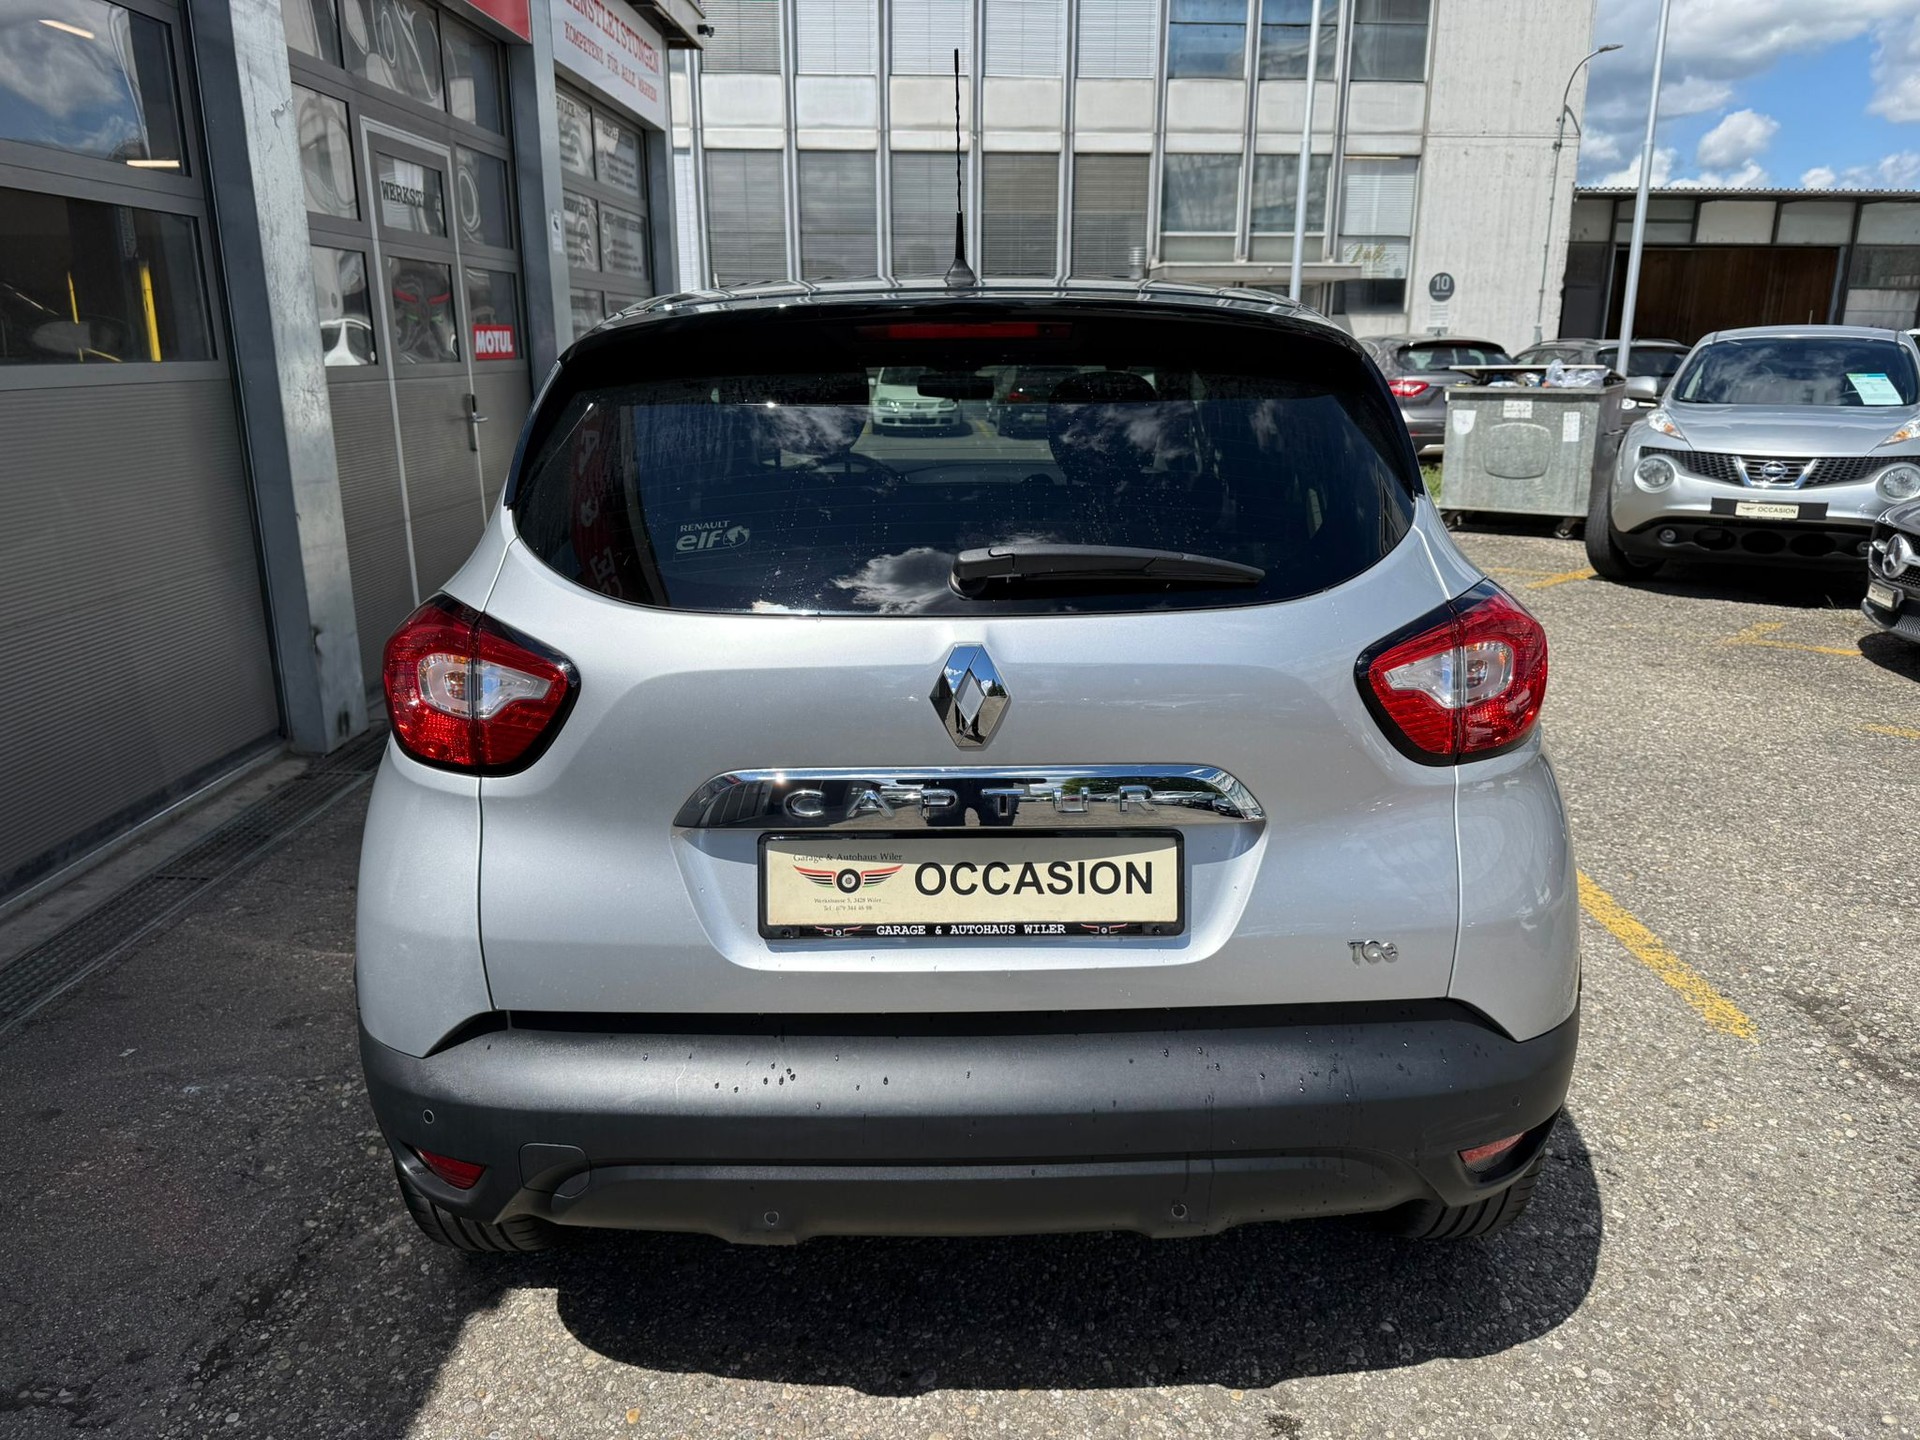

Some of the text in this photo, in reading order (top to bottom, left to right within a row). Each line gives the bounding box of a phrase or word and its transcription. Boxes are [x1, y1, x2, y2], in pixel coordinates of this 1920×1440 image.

[1433, 275, 1450, 291] 10
[475, 329, 514, 355] MOTUL
[1757, 504, 1797, 515] OCCASION
[680, 520, 731, 532] RENAULT
[676, 529, 723, 551] elf
[783, 784, 1160, 818] CAPTUR
[793, 852, 903, 864] Garage & Autohaus Wiler
[914, 861, 1153, 896] OCCASION
[876, 924, 1067, 936] GARAGE & AUTOHAUS WILER
